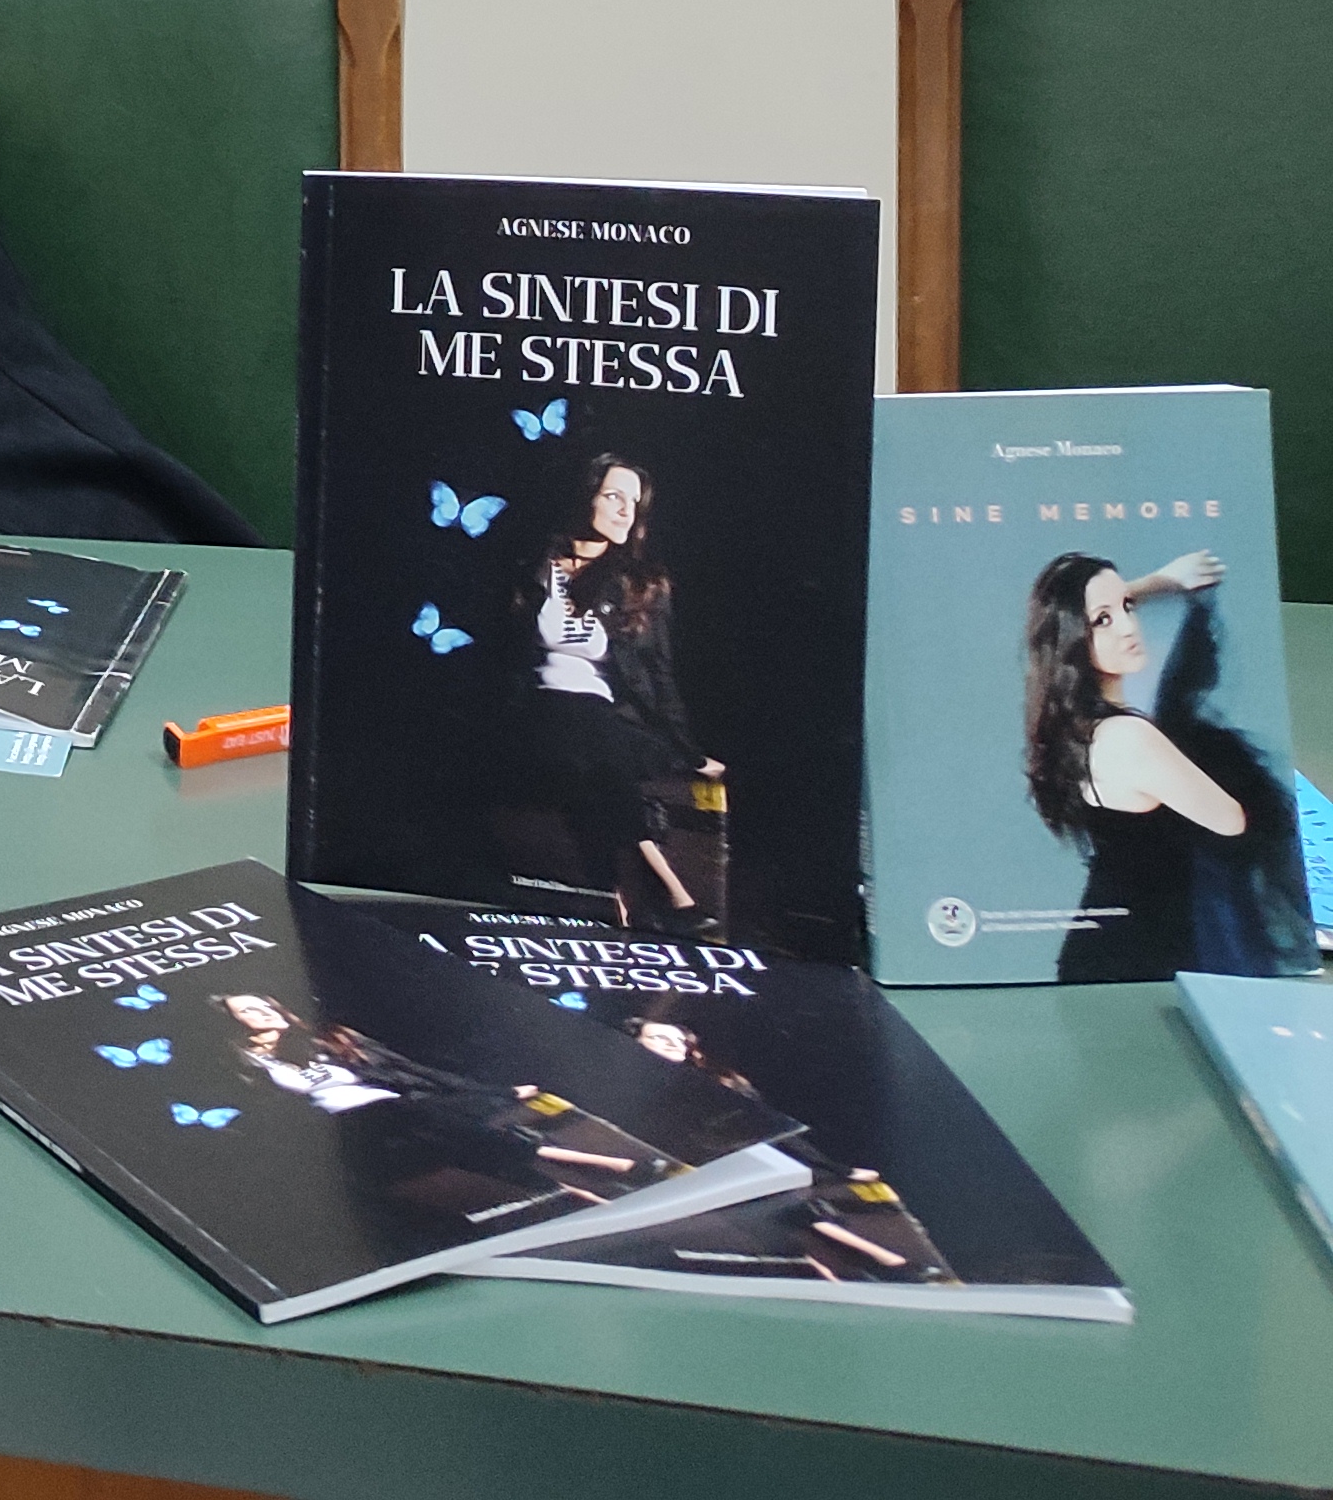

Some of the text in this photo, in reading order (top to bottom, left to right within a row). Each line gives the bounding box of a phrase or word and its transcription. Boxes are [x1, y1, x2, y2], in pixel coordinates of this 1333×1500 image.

[496, 217, 692, 245] AGNESE MONACO
[389, 267, 780, 338] LA SINTESI DI
[418, 329, 745, 398] ME STESSA
[991, 440, 1123, 462] Agnese Monaco
[900, 500, 1222, 524] SINE MEMORE
[8, 915, 200, 960] SINTESI
[190, 901, 262, 930] DI
[77, 929, 278, 989] STESSA
[464, 935, 690, 967] SINTESI
[695, 945, 768, 972] DI
[519, 963, 757, 996] STESSA
